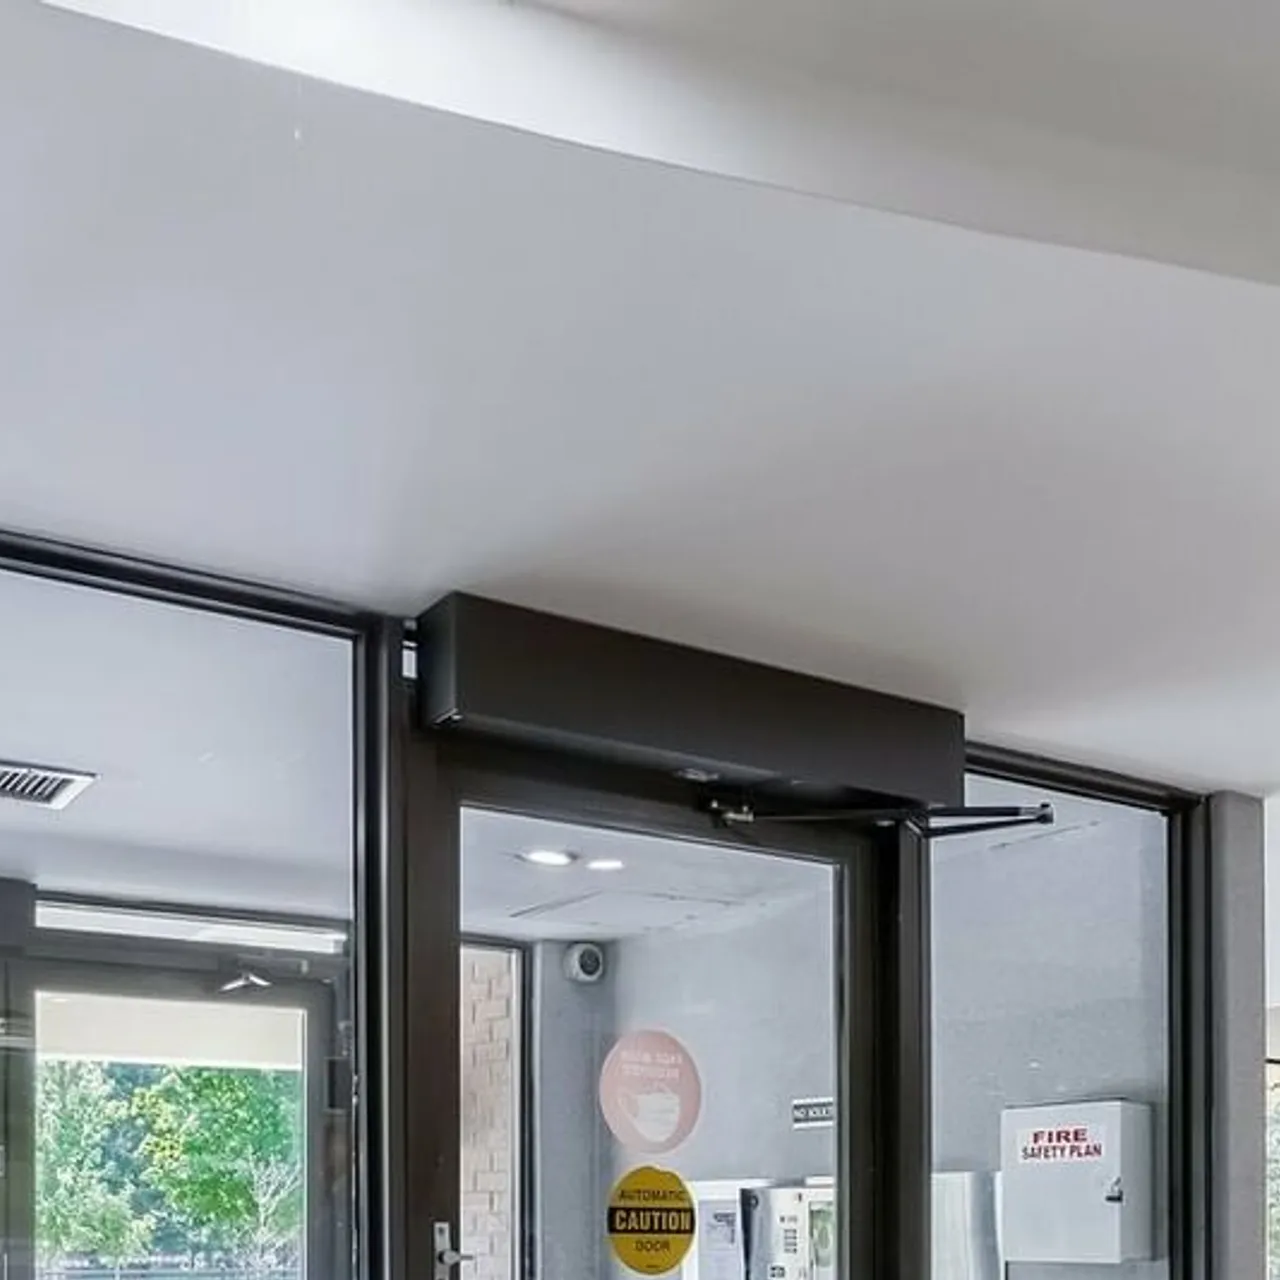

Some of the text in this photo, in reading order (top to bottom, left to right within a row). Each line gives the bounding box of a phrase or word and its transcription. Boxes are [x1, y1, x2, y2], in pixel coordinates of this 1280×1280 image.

[1033, 1128, 1087, 1144] FIRE
[1022, 1143, 1102, 1161] SAFETY PLAN
[617, 1189, 686, 1202] AUTOMATIC
[614, 1209, 692, 1231] CAUTION
[634, 1239, 671, 1252] DOOR
